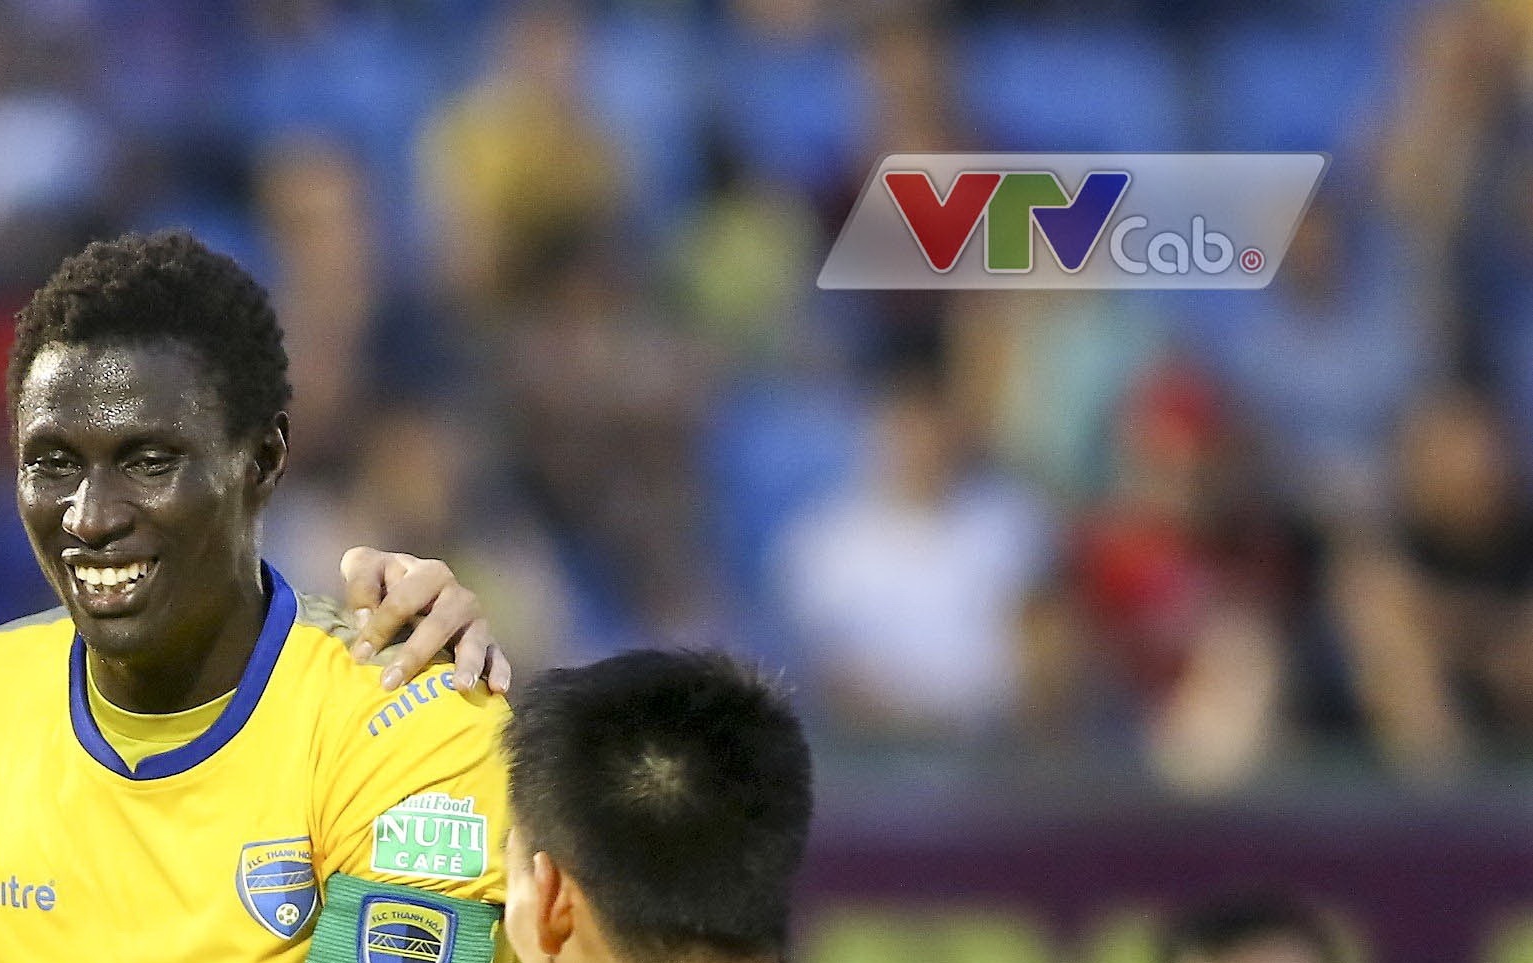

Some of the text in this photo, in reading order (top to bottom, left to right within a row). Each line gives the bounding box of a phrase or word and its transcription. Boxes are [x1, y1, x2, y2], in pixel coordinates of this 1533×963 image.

[368, 671, 458, 736] mitre
[378, 814, 483, 851] NUTI
[394, 852, 463, 874] CAFÉ
